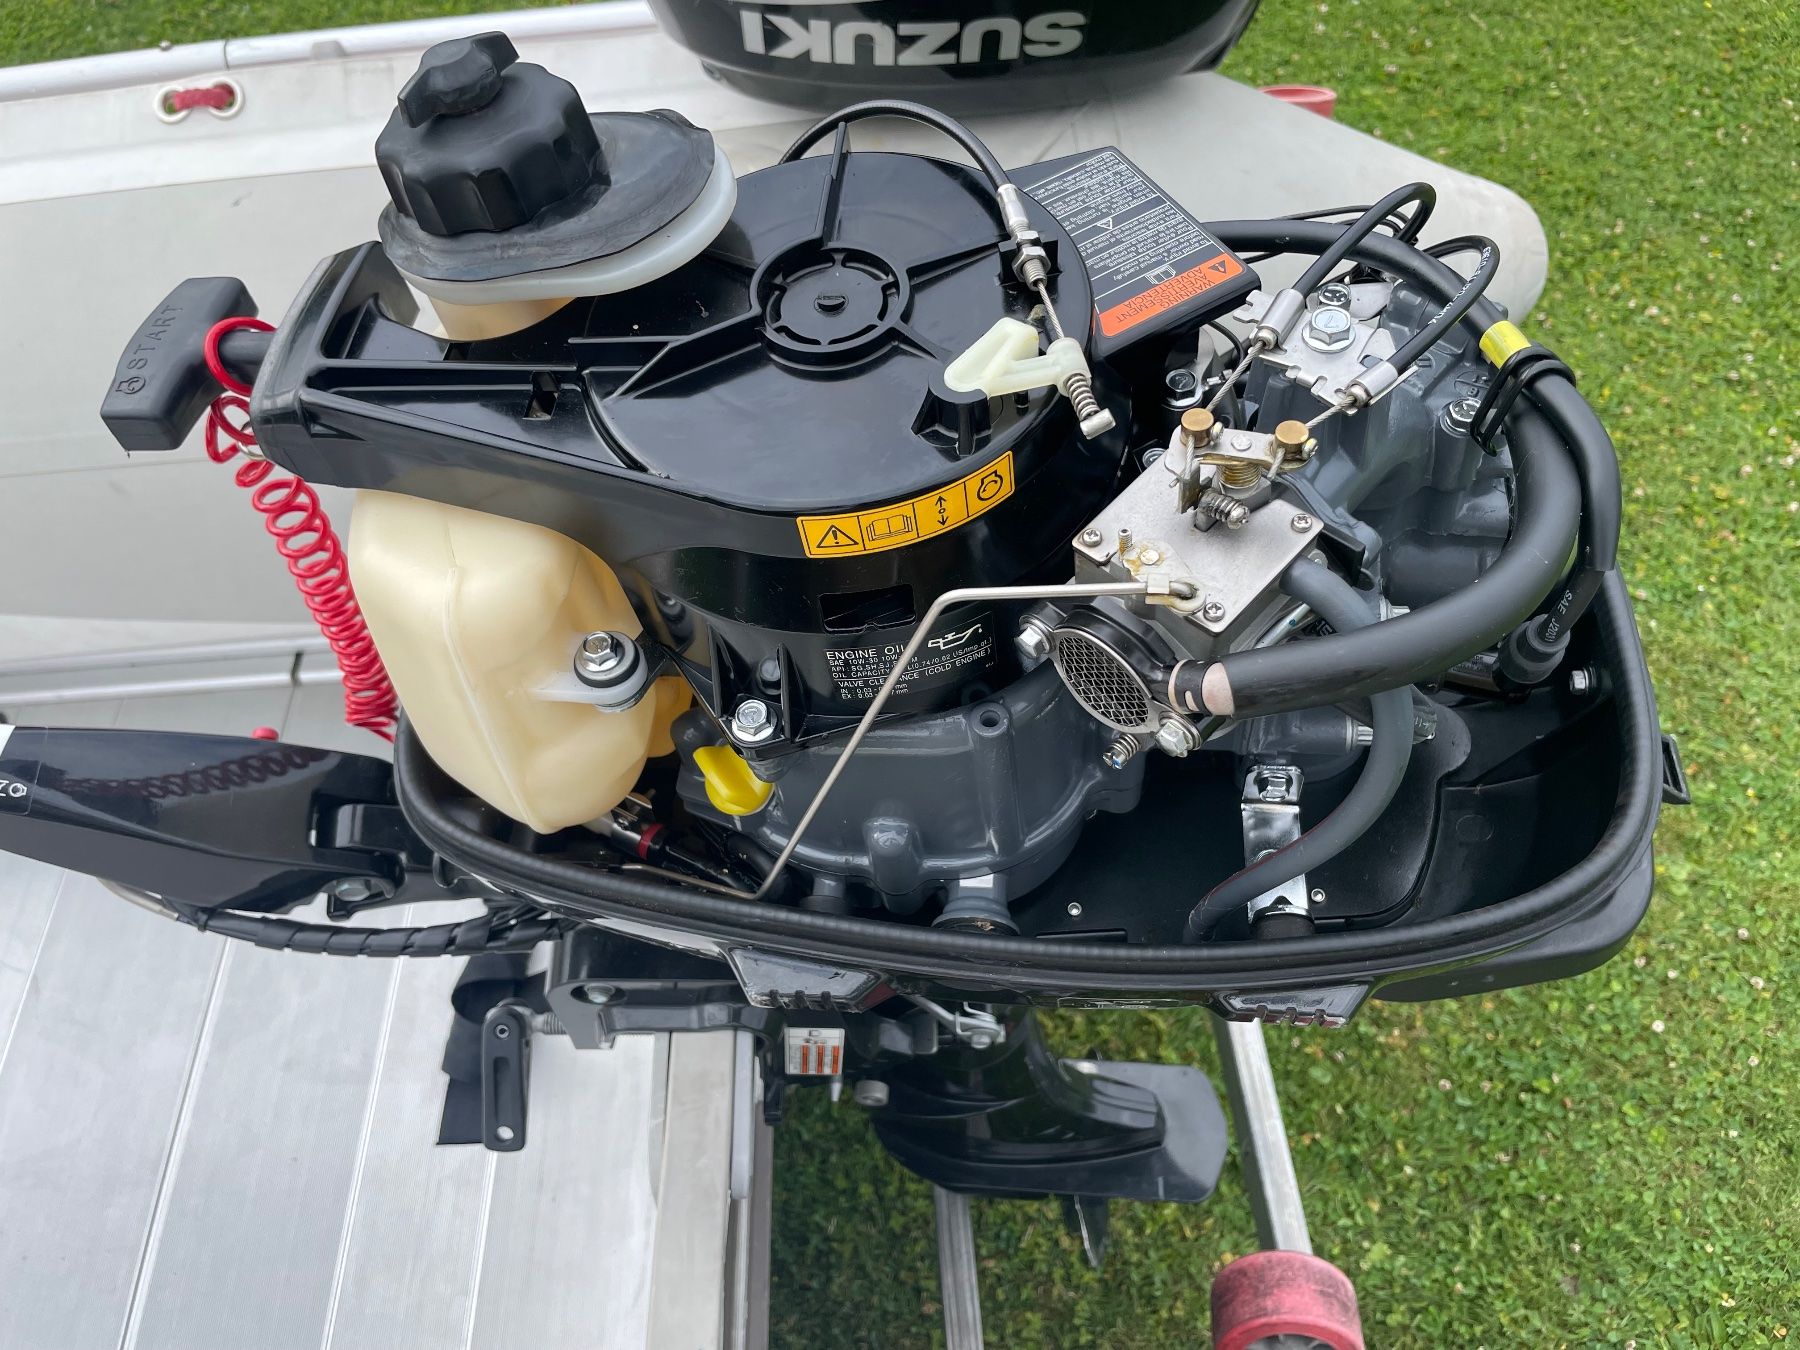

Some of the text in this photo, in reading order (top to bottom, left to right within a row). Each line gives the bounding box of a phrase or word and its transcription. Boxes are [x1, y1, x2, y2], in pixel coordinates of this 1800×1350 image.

[739, 10, 1087, 66] SUZUKI
[1178, 230, 1200, 242] before
[1188, 234, 1205, 244] read
[1148, 240, 1180, 257] operating
[1181, 242, 1201, 253] avoid
[1138, 254, 1163, 268] manual
[1111, 265, 1140, 281] carefully
[1123, 266, 1204, 308] ADVERTENCIA
[1159, 279, 1215, 309] WARNING
[1116, 272, 1208, 322] AVERTISSEMENT
[127, 305, 183, 370] START
[1557, 589, 1573, 615] SAE
[826, 649, 877, 660] ENGINE
[838, 680, 864, 688] VALVE
[925, 663, 952, 677] (COLD
[851, 669, 890, 678] CAPACITY
